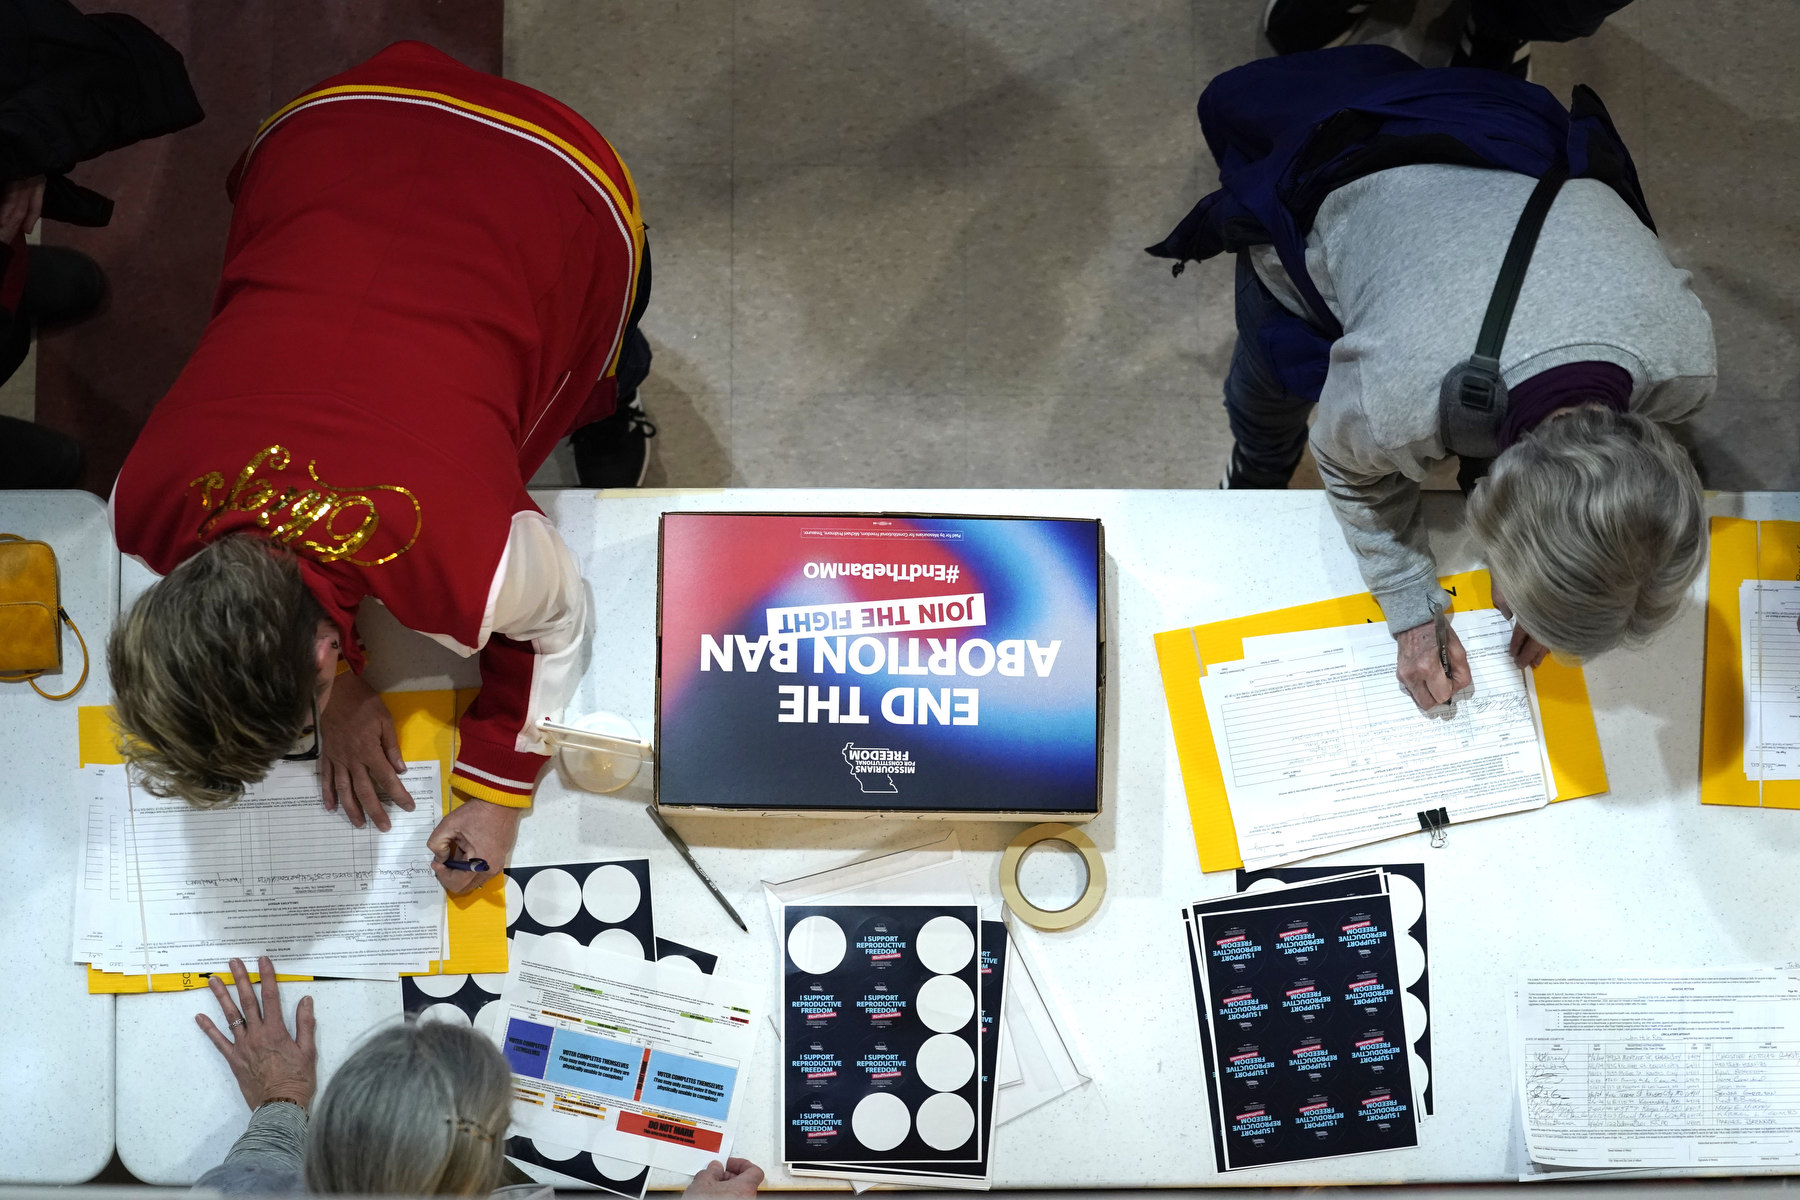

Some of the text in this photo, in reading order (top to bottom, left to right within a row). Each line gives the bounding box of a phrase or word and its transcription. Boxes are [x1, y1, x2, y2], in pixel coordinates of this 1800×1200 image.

[190, 445, 422, 567] Chiefs
[803, 562, 959, 583] #EndTheBanMO
[779, 596, 974, 634] JOIN THE FIGHT
[700, 634, 1061, 677] ABORTION BAN
[779, 685, 978, 726] END THE
[849, 750, 909, 760] FREEDOM
[855, 766, 915, 774] MISSOURIANS
[1346, 926, 1378, 934] FREEDOM
[1283, 933, 1315, 941] FREEDOM
[1338, 931, 1387, 942] REPRODUCTIVE
[1221, 940, 1253, 948] FREEDOM
[1275, 938, 1324, 949] REPRODUCTIVE
[1347, 939, 1376, 947] SUPPORT
[1213, 945, 1262, 956] REPRODUCTIVE
[1284, 946, 1313, 954] SUPPORT
[1222, 953, 1251, 961] SUPPORT
[1353, 984, 1385, 992] FREEDOM
[1290, 991, 1322, 999] FREEDOM
[1345, 989, 1394, 1000] REPRODUCTIVE
[1227, 999, 1259, 1007] FREEDOM
[1282, 996, 1331, 1007] REPRODUCTIVE
[1354, 997, 1383, 1005] SUPPORT
[1219, 1004, 1268, 1015] REPRODUCTIVE
[1291, 1004, 1320, 1012] SUPPORT
[1228, 1012, 1257, 1020] SUPPORT
[1359, 1042, 1391, 1050] FREEDOM
[1297, 1050, 1329, 1058] FREEDOM
[1351, 1047, 1400, 1058] REPRODUCTIVE
[563, 1049, 629, 1069] VOTER COMPLETES THEMSELVES
[1234, 1057, 1266, 1065] FREEDOM
[1289, 1055, 1338, 1066] REPRODUCTIVE
[1360, 1055, 1389, 1063] SUPPORT
[1226, 1062, 1275, 1073] REPRODUCTIVE
[1298, 1063, 1327, 1071] SUPPORT
[1235, 1070, 1264, 1078] SUPPORT
[671, 1074, 696, 1084] COMPLETES
[697, 1080, 724, 1090] THEMSELVES
[1366, 1100, 1398, 1108] FREEDOM
[1303, 1108, 1335, 1116] FREEDOM
[1358, 1105, 1407, 1116] REPRODUCTIVE
[1240, 1115, 1272, 1123] FREEDOM
[1295, 1113, 1344, 1124] REPRODUCTIVE
[1367, 1113, 1396, 1121] SUPPORT
[648, 1120, 658, 1130] DO
[659, 1122, 673, 1134] NOT
[674, 1125, 695, 1138] MARK
[1232, 1120, 1281, 1131] REPRODUCTIVE
[1304, 1121, 1333, 1129] SUPPORT
[1241, 1128, 1270, 1136] SUPPORT
